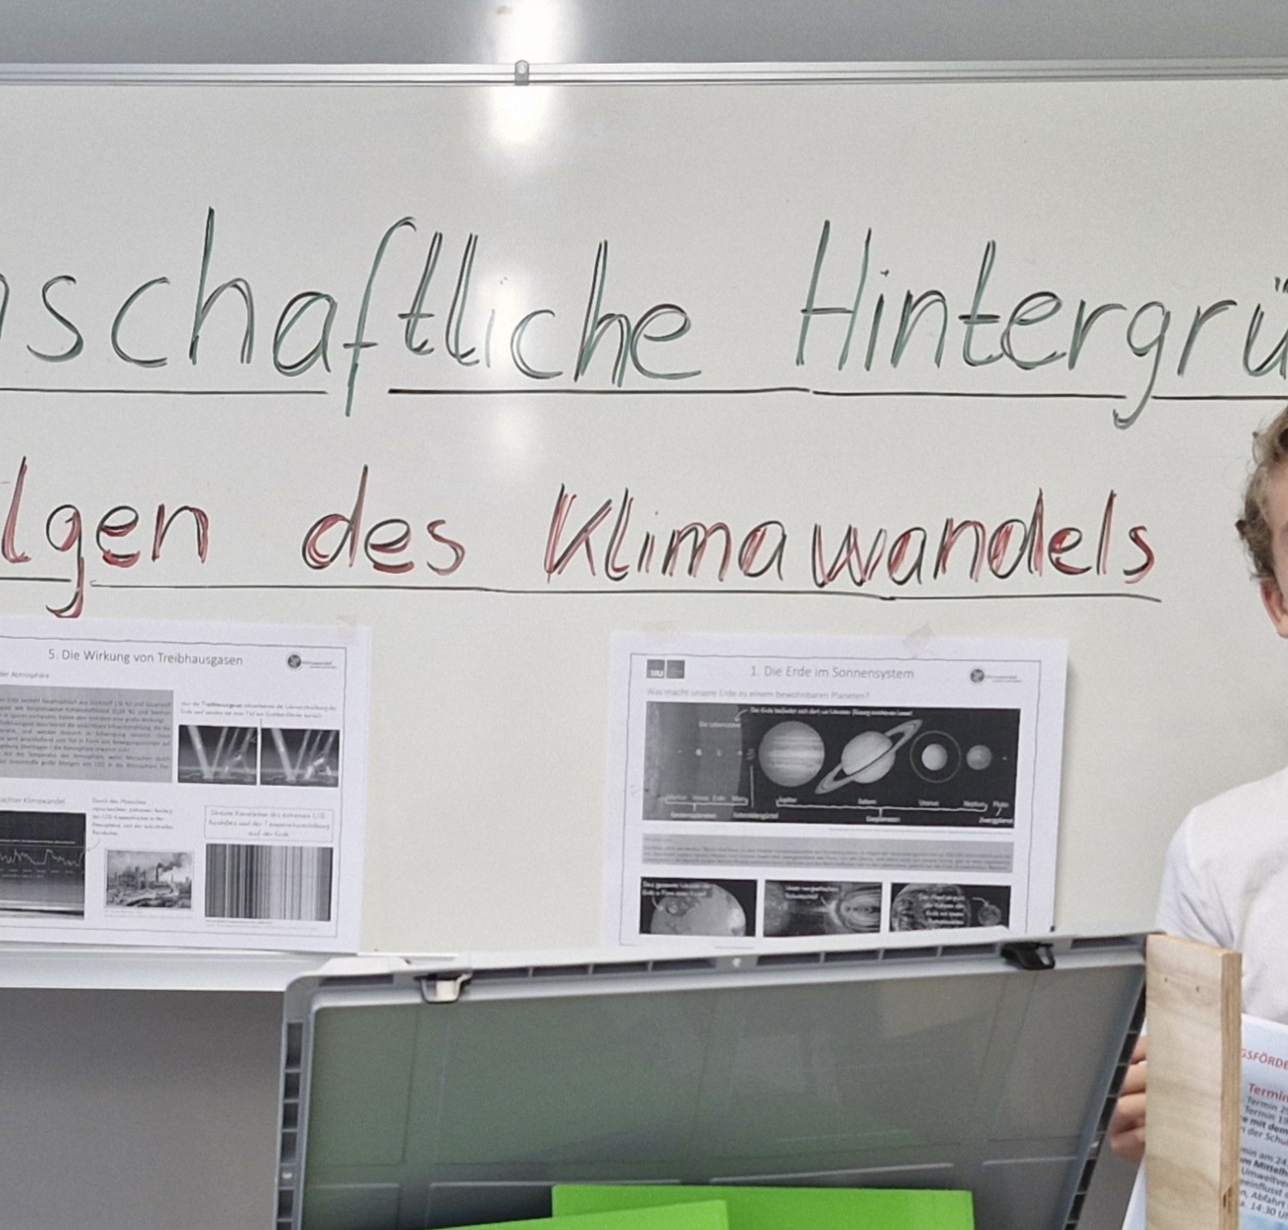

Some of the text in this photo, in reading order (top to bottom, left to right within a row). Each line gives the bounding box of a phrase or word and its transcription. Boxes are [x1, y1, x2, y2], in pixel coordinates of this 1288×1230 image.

[301, 464, 467, 576] des
[543, 483, 1157, 588] Klimawandels
[48, 648, 244, 667] 5. Die Wirkung von Treibhausgasen
[751, 665, 915, 681] 1. Die Erde im Sonnensystem
[1247, 1096, 1278, 1112] Termin
[1245, 1105, 1276, 1121] Termin
[1247, 1127, 1263, 1138] der
[1249, 1117, 1267, 1129] mit
[1267, 1122, 1288, 1137] dem
[1259, 1153, 1274, 1163] am
[1251, 1191, 1286, 1210] Abfahrt
[1250, 1201, 1277, 1217] 14:30
